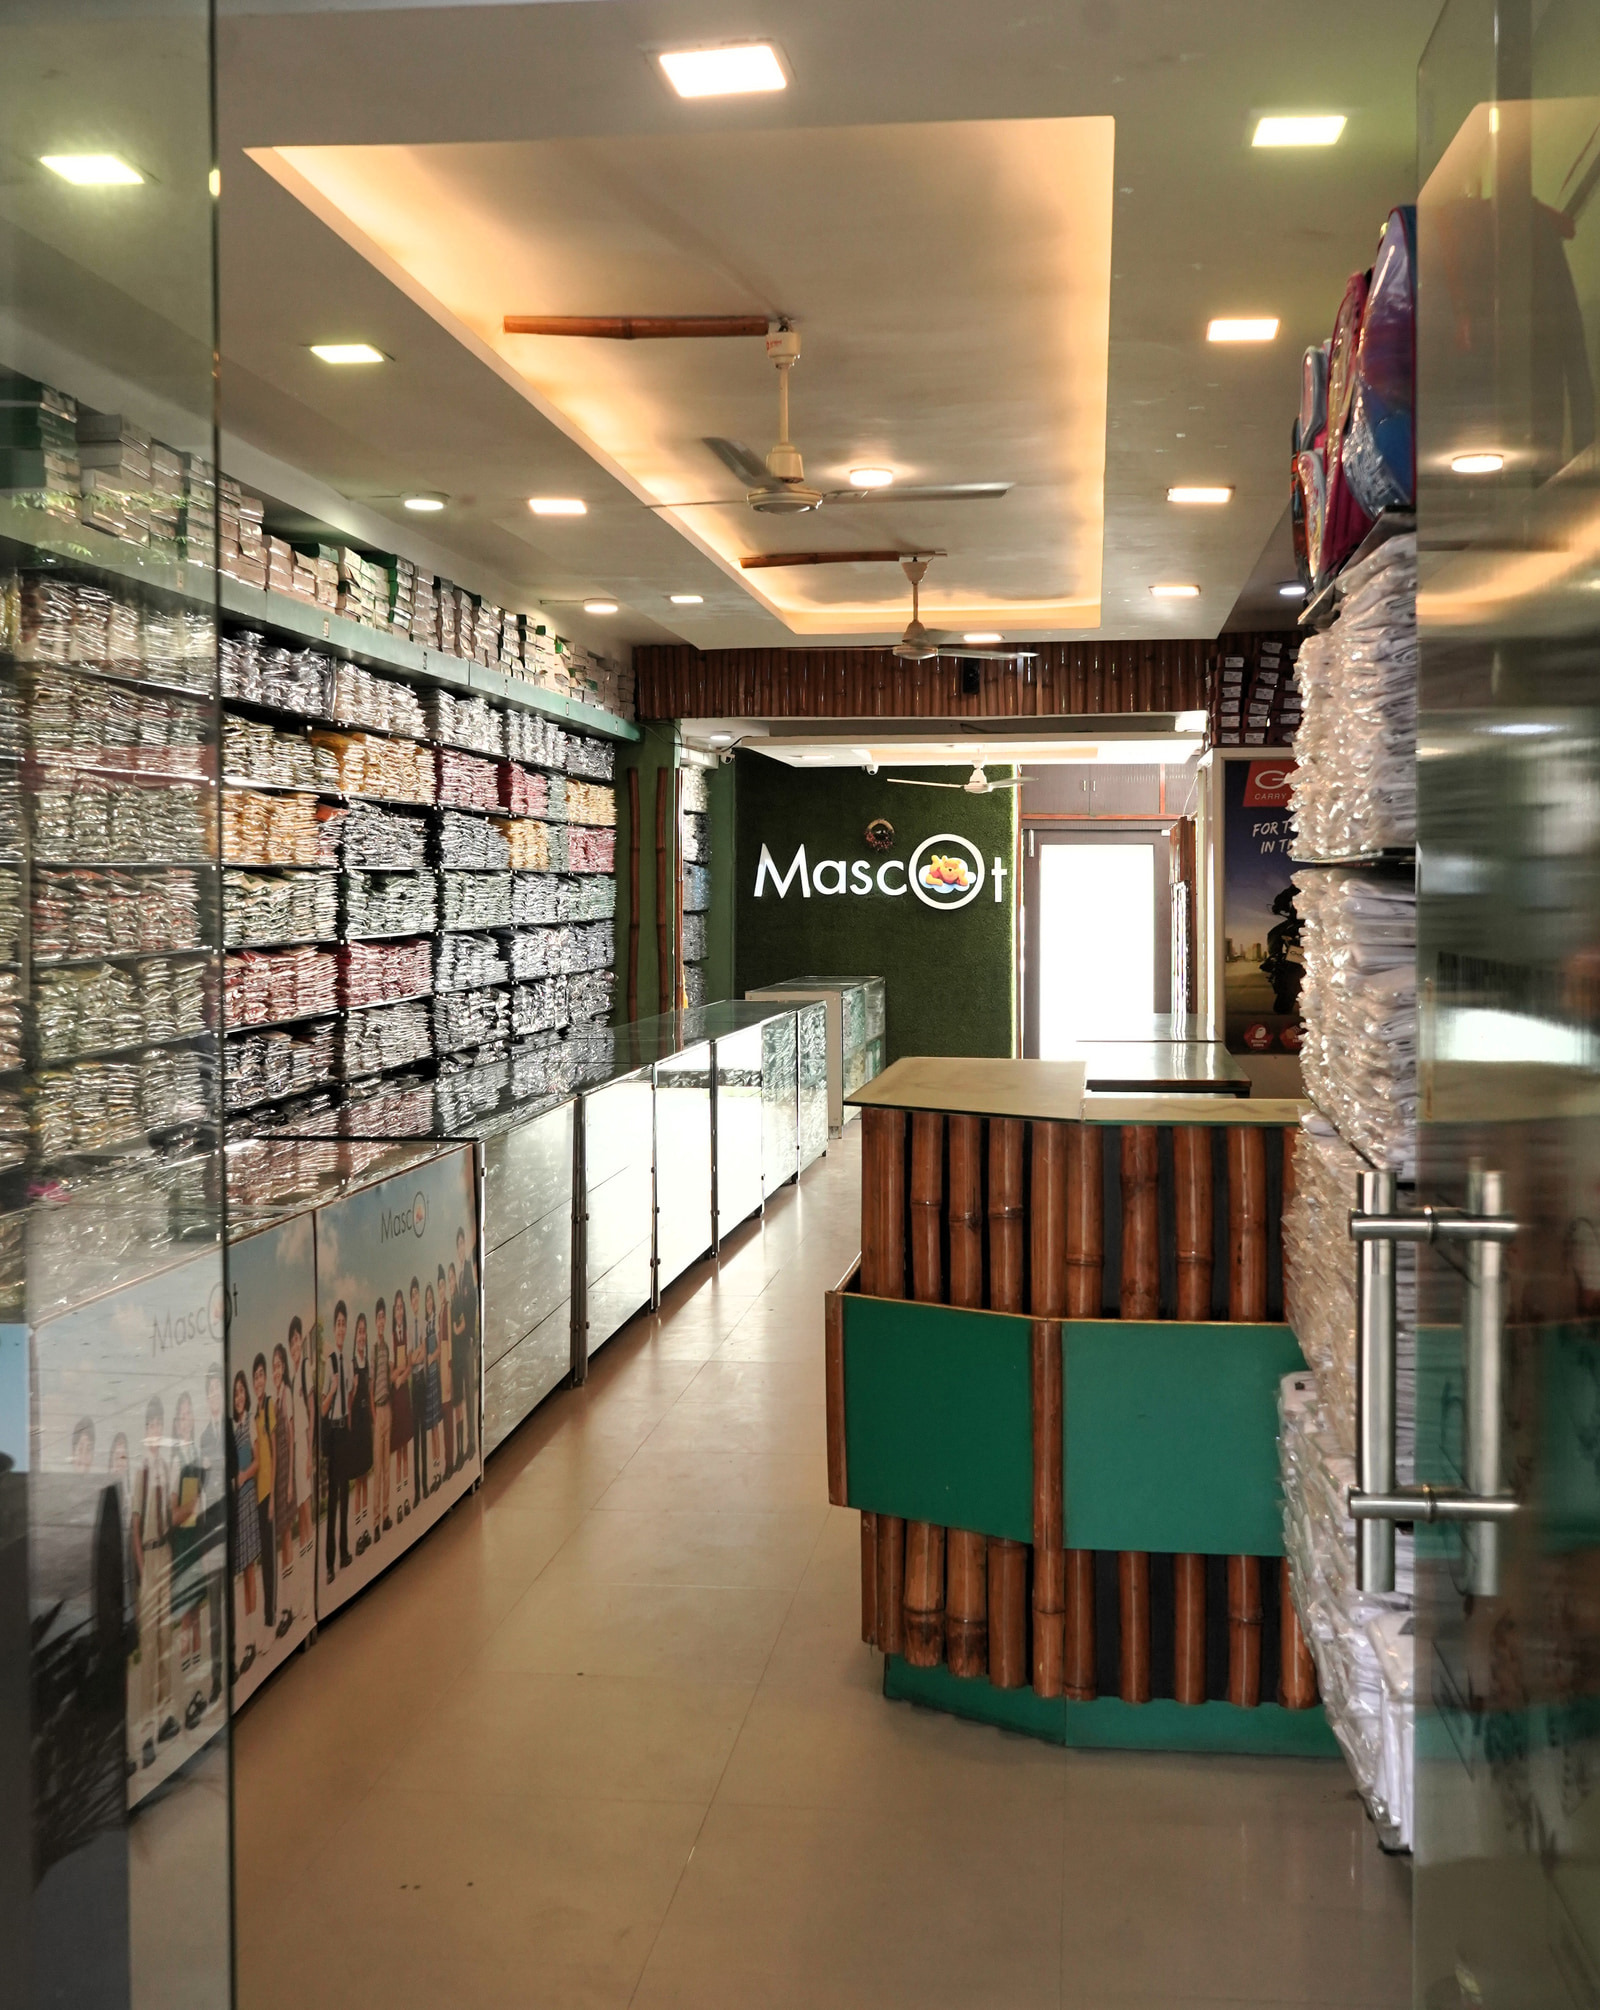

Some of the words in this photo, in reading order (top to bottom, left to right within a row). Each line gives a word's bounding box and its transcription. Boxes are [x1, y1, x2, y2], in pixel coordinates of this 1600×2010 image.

[1254, 792, 1287, 801] CARRY
[1252, 821, 1279, 838] FOR
[1260, 841, 1276, 855] IN
